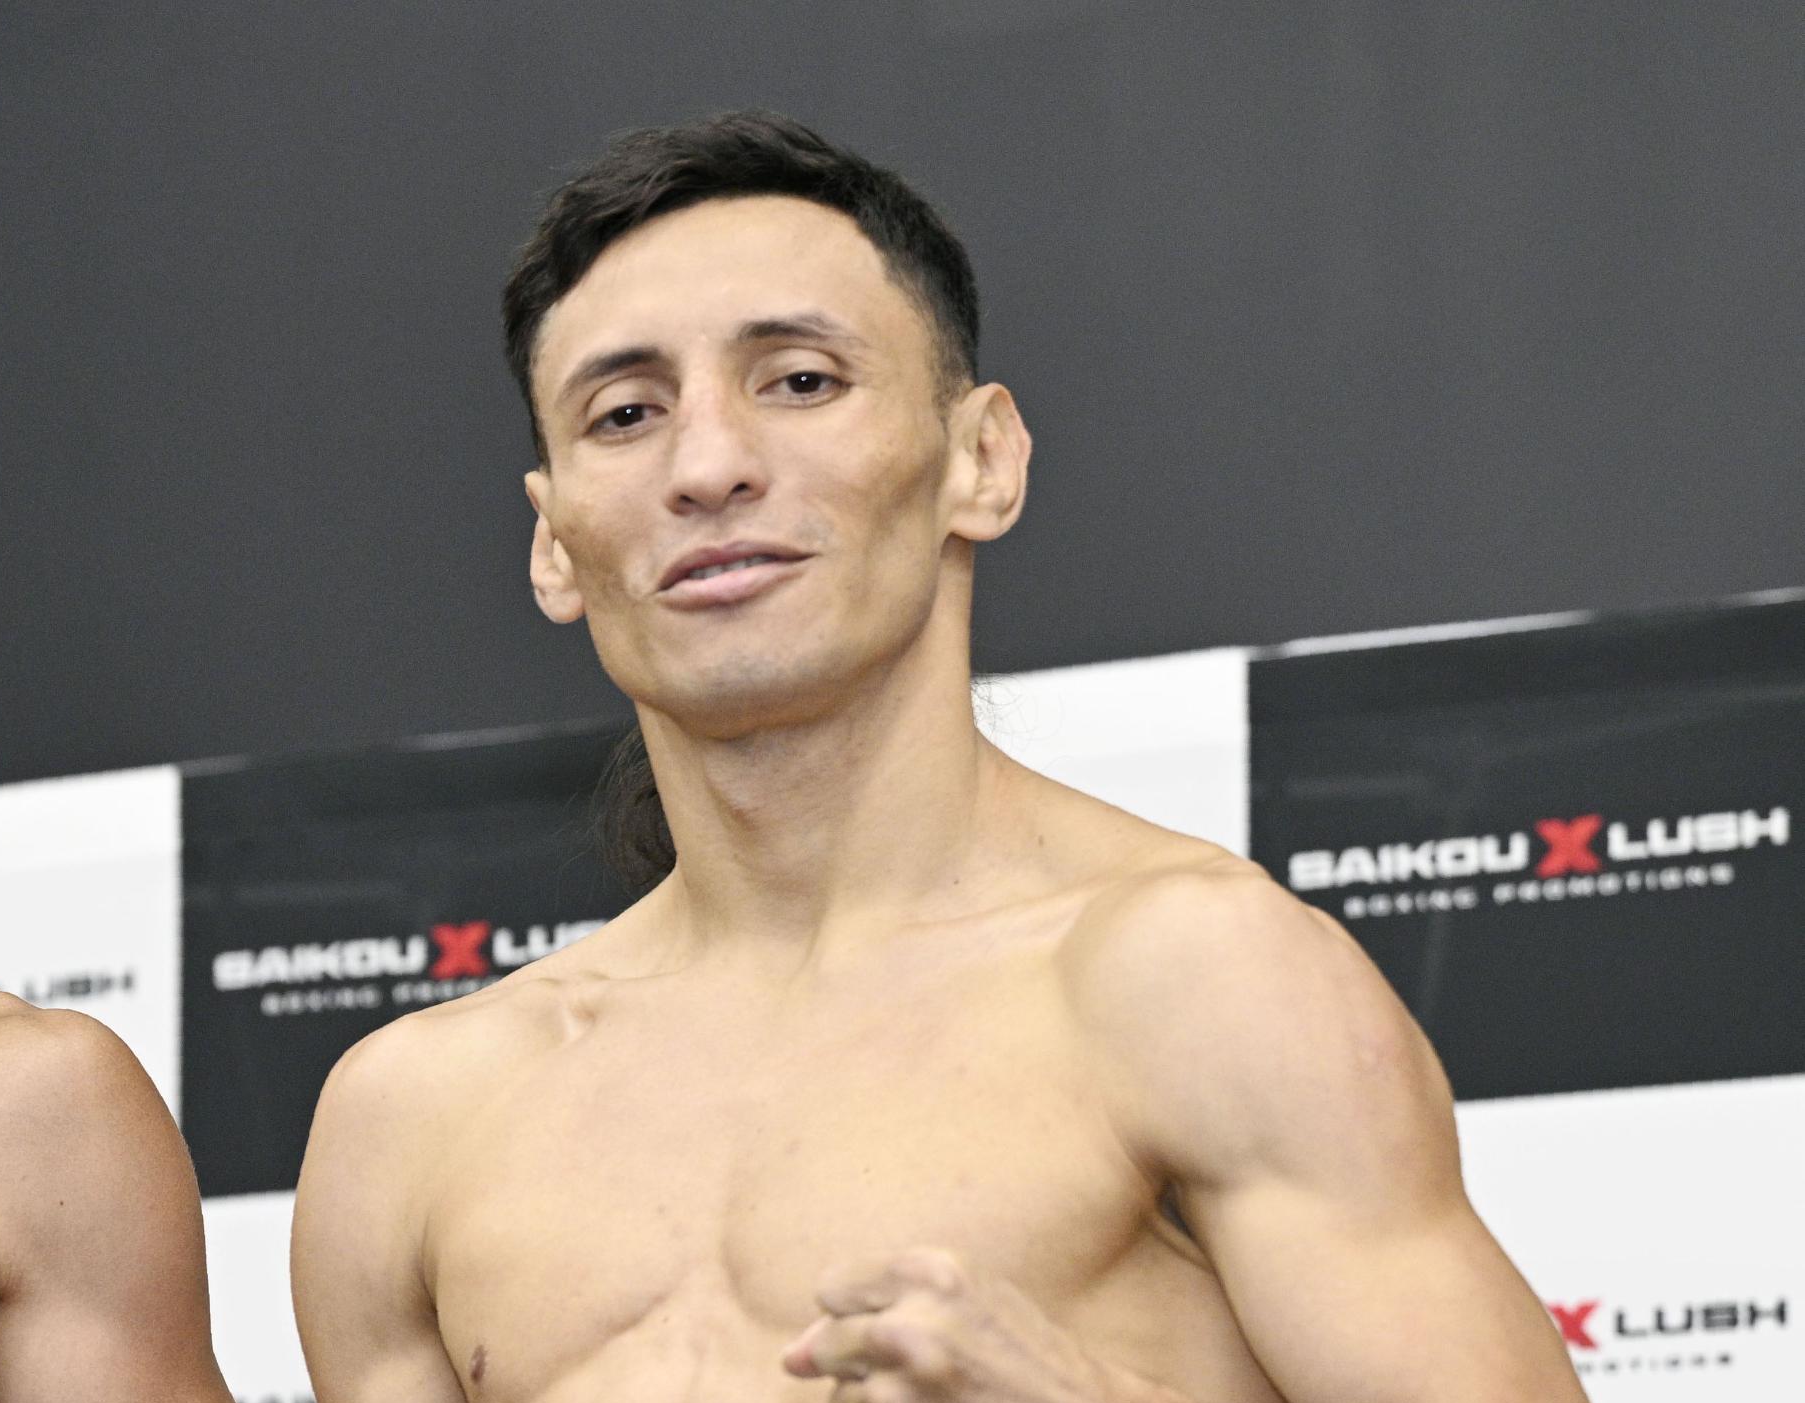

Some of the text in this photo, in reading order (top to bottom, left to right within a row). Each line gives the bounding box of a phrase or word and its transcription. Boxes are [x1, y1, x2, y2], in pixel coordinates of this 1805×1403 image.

[1289, 807, 1790, 890] SAIKOU X LUSH
[212, 934, 428, 991] SAIKOU
[430, 920, 490, 980] X
[1614, 1299, 1787, 1337] LUSH
